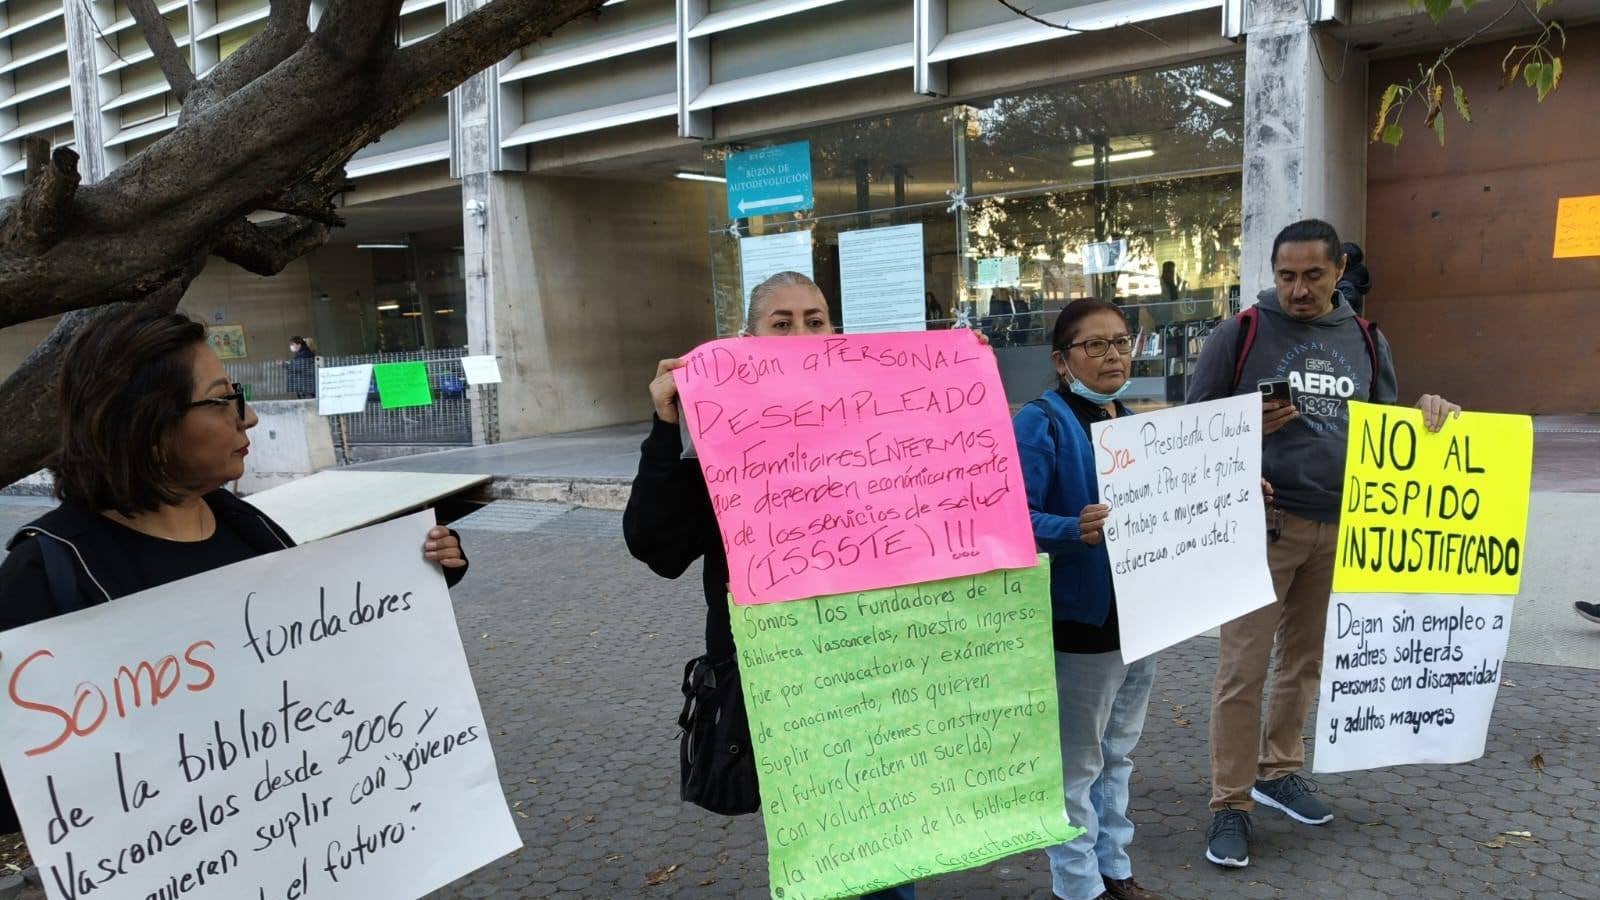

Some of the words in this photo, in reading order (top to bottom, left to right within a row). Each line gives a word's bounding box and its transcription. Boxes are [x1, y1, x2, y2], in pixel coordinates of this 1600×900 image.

[778, 164, 789, 173] DE
[823, 338, 979, 371] PERSONAL
[1305, 359, 1334, 372] EST.
[1289, 371, 1354, 398] AERO
[1298, 396, 1341, 417] 1987
[694, 381, 986, 439] DESEMPLEADO
[1140, 414, 1204, 459] Presidenta
[1208, 411, 1250, 443] Claudia
[1361, 412, 1417, 472] NO
[1443, 434, 1486, 473] AL
[705, 462, 738, 484] con
[1181, 467, 1197, 494] qué
[1203, 454, 1211, 480] le
[1215, 446, 1248, 483] quita
[734, 520, 756, 547] de
[769, 522, 808, 547] los
[808, 506, 901, 536] servicios
[906, 495, 932, 520] de
[939, 475, 1010, 512] salud
[754, 480, 859, 514] dependen
[1107, 523, 1120, 542] el
[1124, 511, 1158, 537] trabajo
[1162, 510, 1169, 523] a
[1174, 502, 1209, 525] mujeres
[1213, 495, 1232, 516] que
[1237, 488, 1250, 503] se
[1348, 475, 1480, 521] DESPIDO
[1175, 536, 1197, 557] como
[1201, 520, 1238, 547] usted?
[1341, 525, 1520, 576] INJUSTIFICADO
[744, 607, 799, 639] Somos
[815, 600, 848, 625] los
[966, 577, 987, 600] de
[1003, 571, 1022, 594] la
[907, 611, 968, 639] nuestro
[977, 607, 1036, 633] ingreso
[1337, 602, 1383, 650] Dejan
[1392, 611, 1415, 634] sin
[1422, 606, 1486, 645] empleo
[1493, 614, 1504, 630] a
[8, 639, 216, 757] Somos
[243, 581, 412, 664] fundadores
[781, 683, 804, 707] por
[814, 654, 915, 689] convocatoria
[921, 655, 930, 675] y
[940, 636, 1025, 662] exámenes
[1335, 641, 1388, 670] madres
[1393, 639, 1464, 664] solteras
[1331, 670, 1386, 702] personas
[1392, 671, 1412, 690] con
[1416, 659, 1499, 695] discapacidad
[758, 720, 773, 744] de
[892, 687, 919, 705] nos
[926, 671, 990, 702] quieren
[1329, 718, 1339, 744] y
[1344, 706, 1385, 732] adultos
[1390, 707, 1455, 734] mayores
[47, 774, 94, 846] de
[114, 751, 160, 813] la
[178, 679, 354, 783] biblioteca
[823, 738, 851, 758] con
[866, 720, 921, 755] jóvenes
[770, 791, 785, 814] el
[910, 749, 927, 768] un
[1009, 731, 1022, 754] y
[931, 777, 956, 794] sin
[50, 794, 241, 900] Vasconcelos
[253, 750, 322, 802] desde
[337, 700, 407, 765] 2006
[417, 706, 438, 735] y
[252, 792, 333, 852] suplir
[349, 766, 386, 805] con
[784, 859, 806, 886] la
[921, 817, 939, 835] de
[950, 806, 966, 825] la
[286, 856, 308, 900] el
